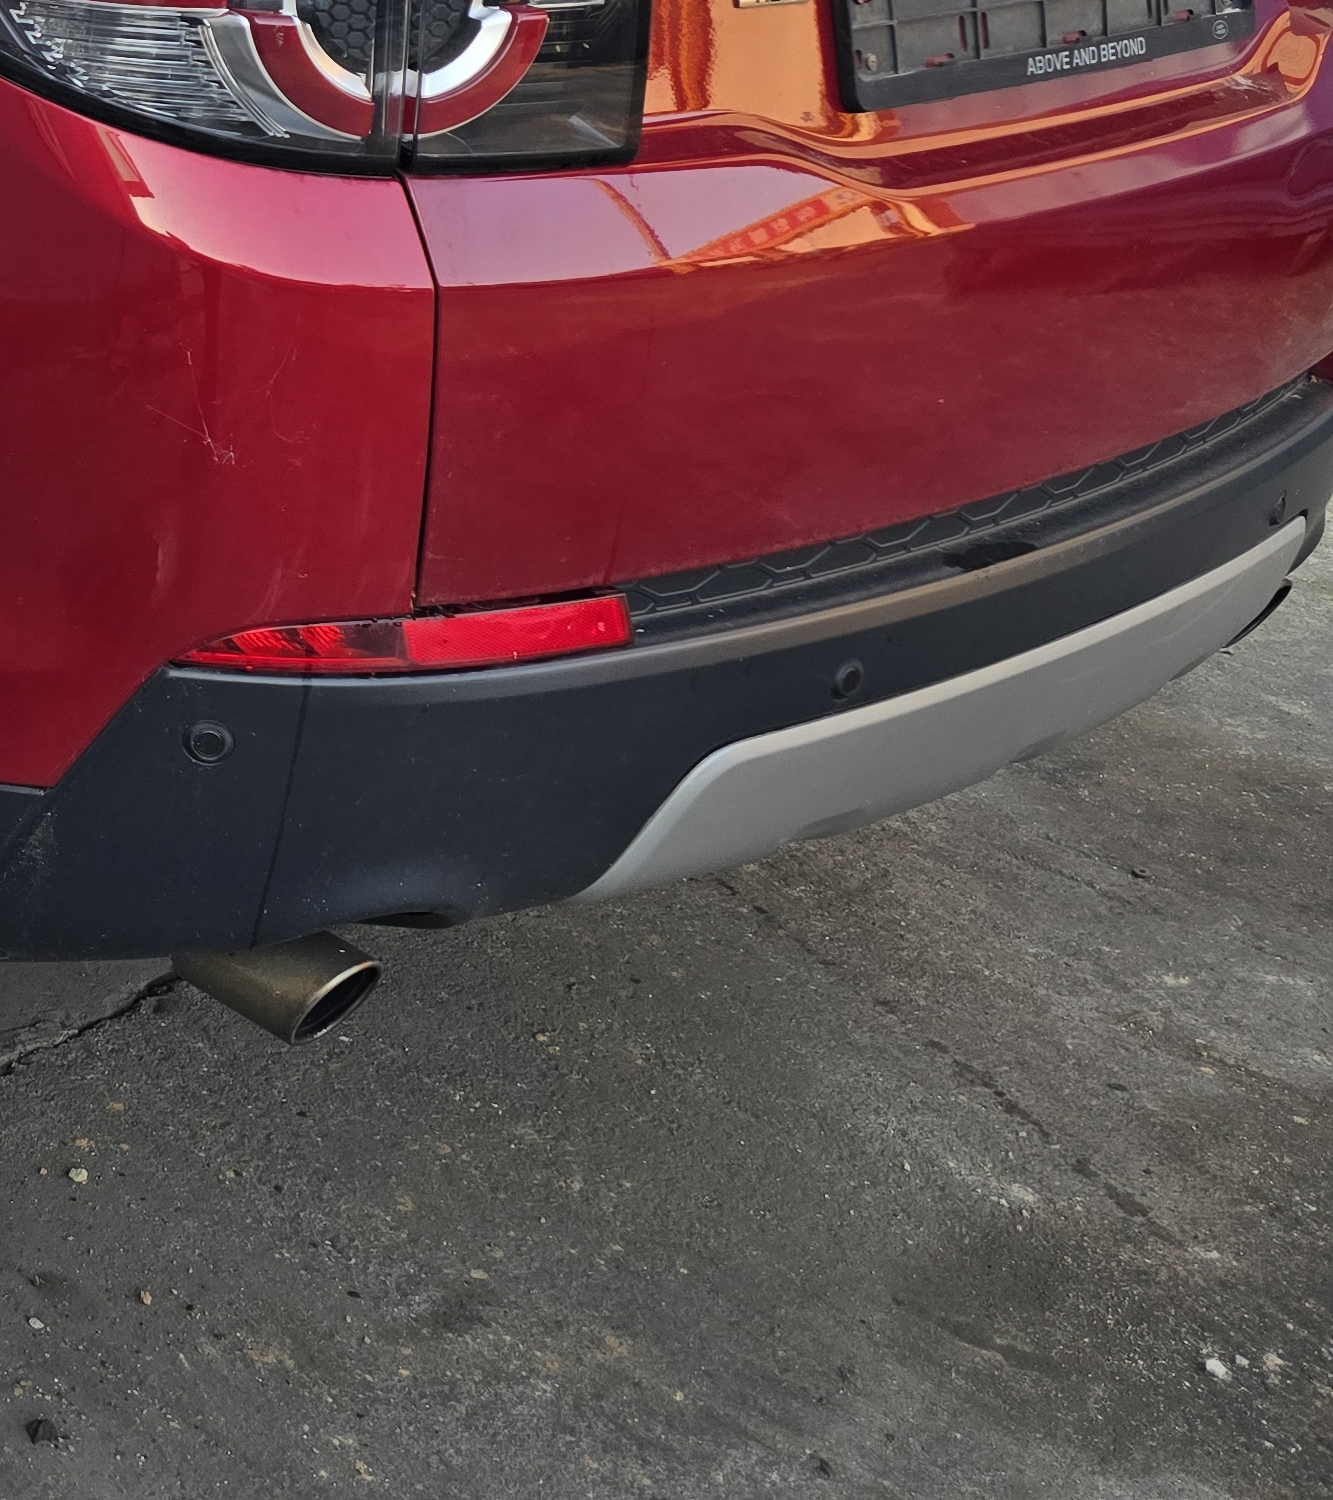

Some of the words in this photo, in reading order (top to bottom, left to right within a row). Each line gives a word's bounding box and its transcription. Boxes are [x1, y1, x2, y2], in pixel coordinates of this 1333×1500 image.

[1026, 51, 1071, 76] ABOVE
[1072, 46, 1098, 68] AND
[1100, 36, 1147, 63] BEYOND
